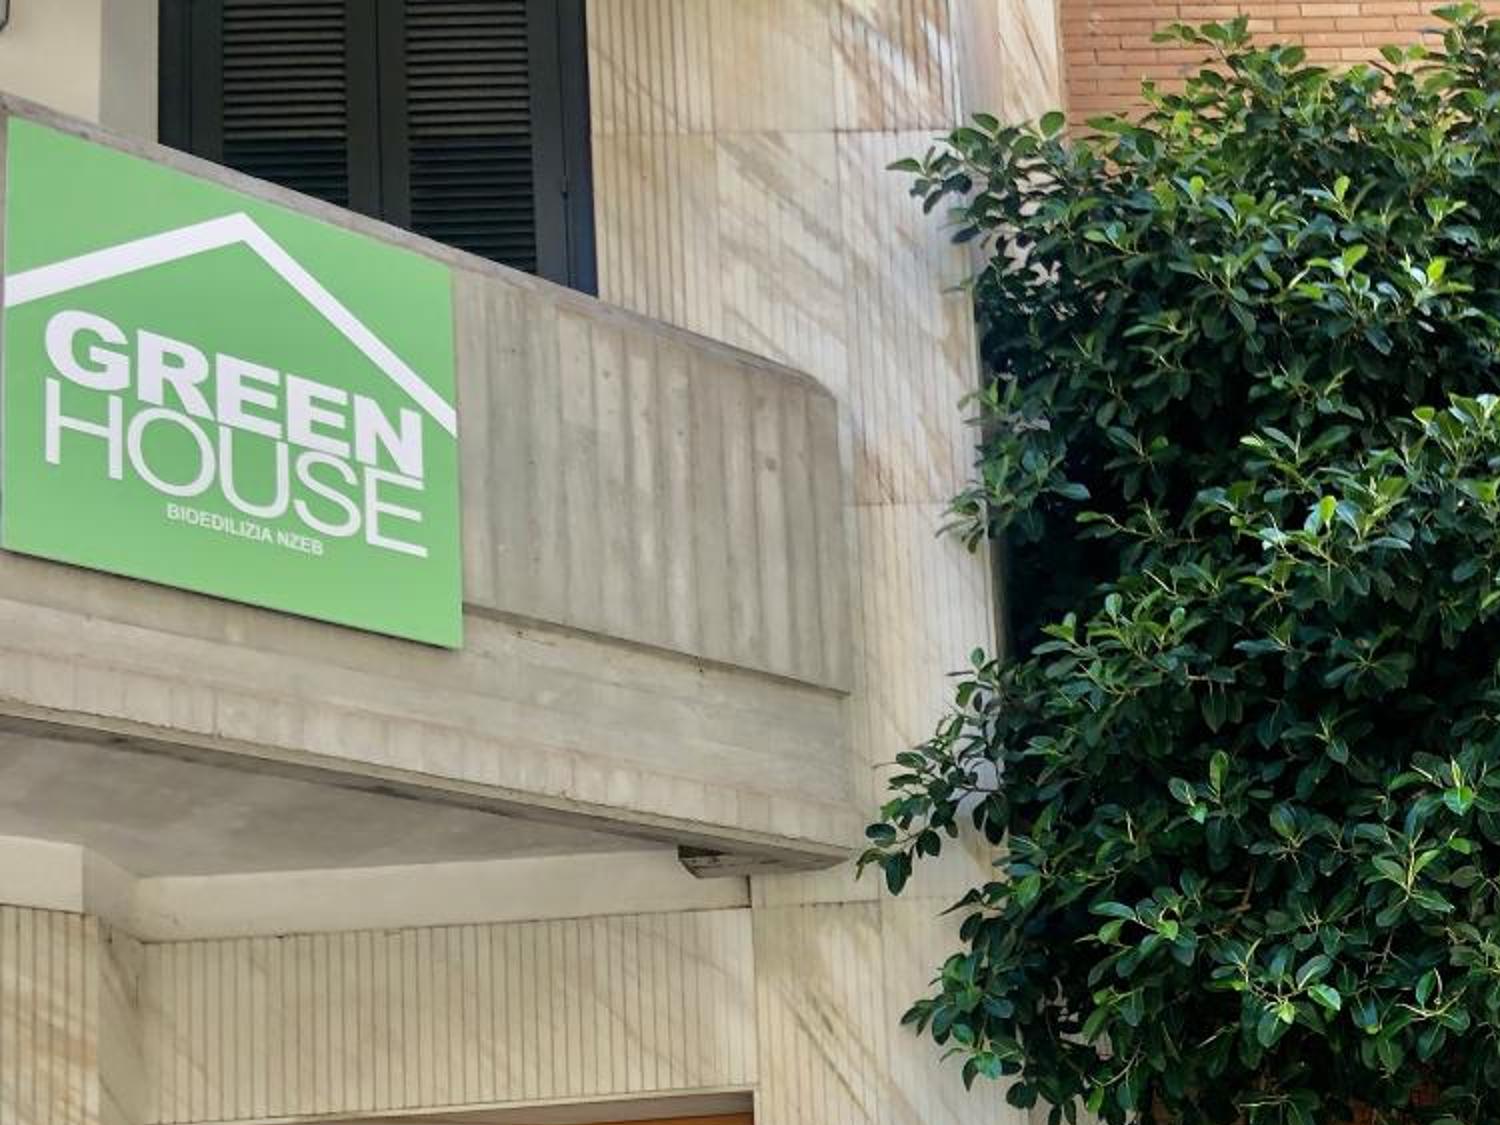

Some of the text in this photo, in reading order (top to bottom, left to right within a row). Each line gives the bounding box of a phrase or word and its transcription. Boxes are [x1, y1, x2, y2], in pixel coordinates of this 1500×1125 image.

[45, 309, 424, 480] GREEN
[45, 377, 429, 559] HOUSE
[166, 502, 325, 556] BIOEDILIZIA NZEB
